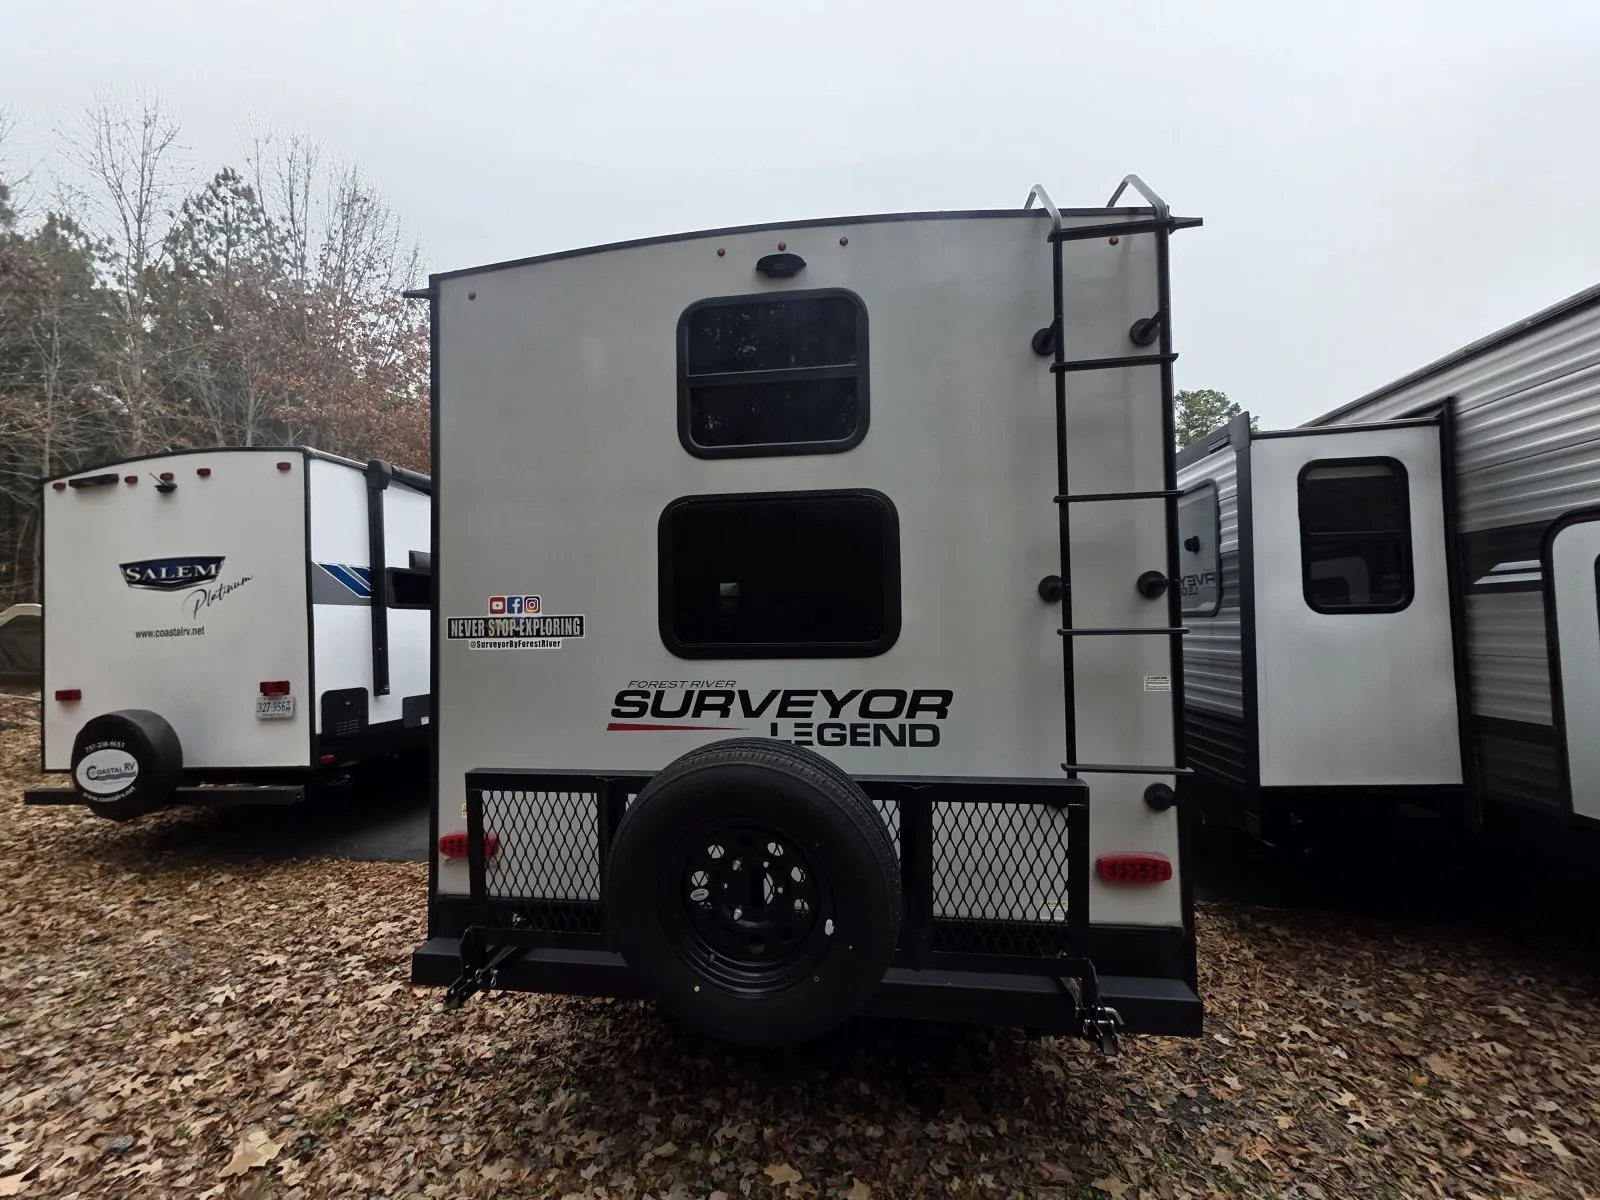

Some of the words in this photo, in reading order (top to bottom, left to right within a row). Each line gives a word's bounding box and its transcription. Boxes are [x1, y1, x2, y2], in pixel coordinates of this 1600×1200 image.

[126, 563, 219, 581] SALEM
[182, 575, 255, 620] Platinum
[135, 626, 205, 639] www.coastalrv.net
[451, 619, 485, 637] NEVER
[488, 618, 517, 637] STOP
[519, 617, 580, 637] EXPLORING
[470, 640, 561, 649] @SurveyorByForestRiver
[628, 680, 688, 689] FOREST
[690, 680, 737, 689] RIVER
[610, 689, 954, 720] SURVEYOR
[770, 722, 941, 748] LEGEND
[87, 765, 123, 781] COASTAL
[124, 762, 136, 772] RV
